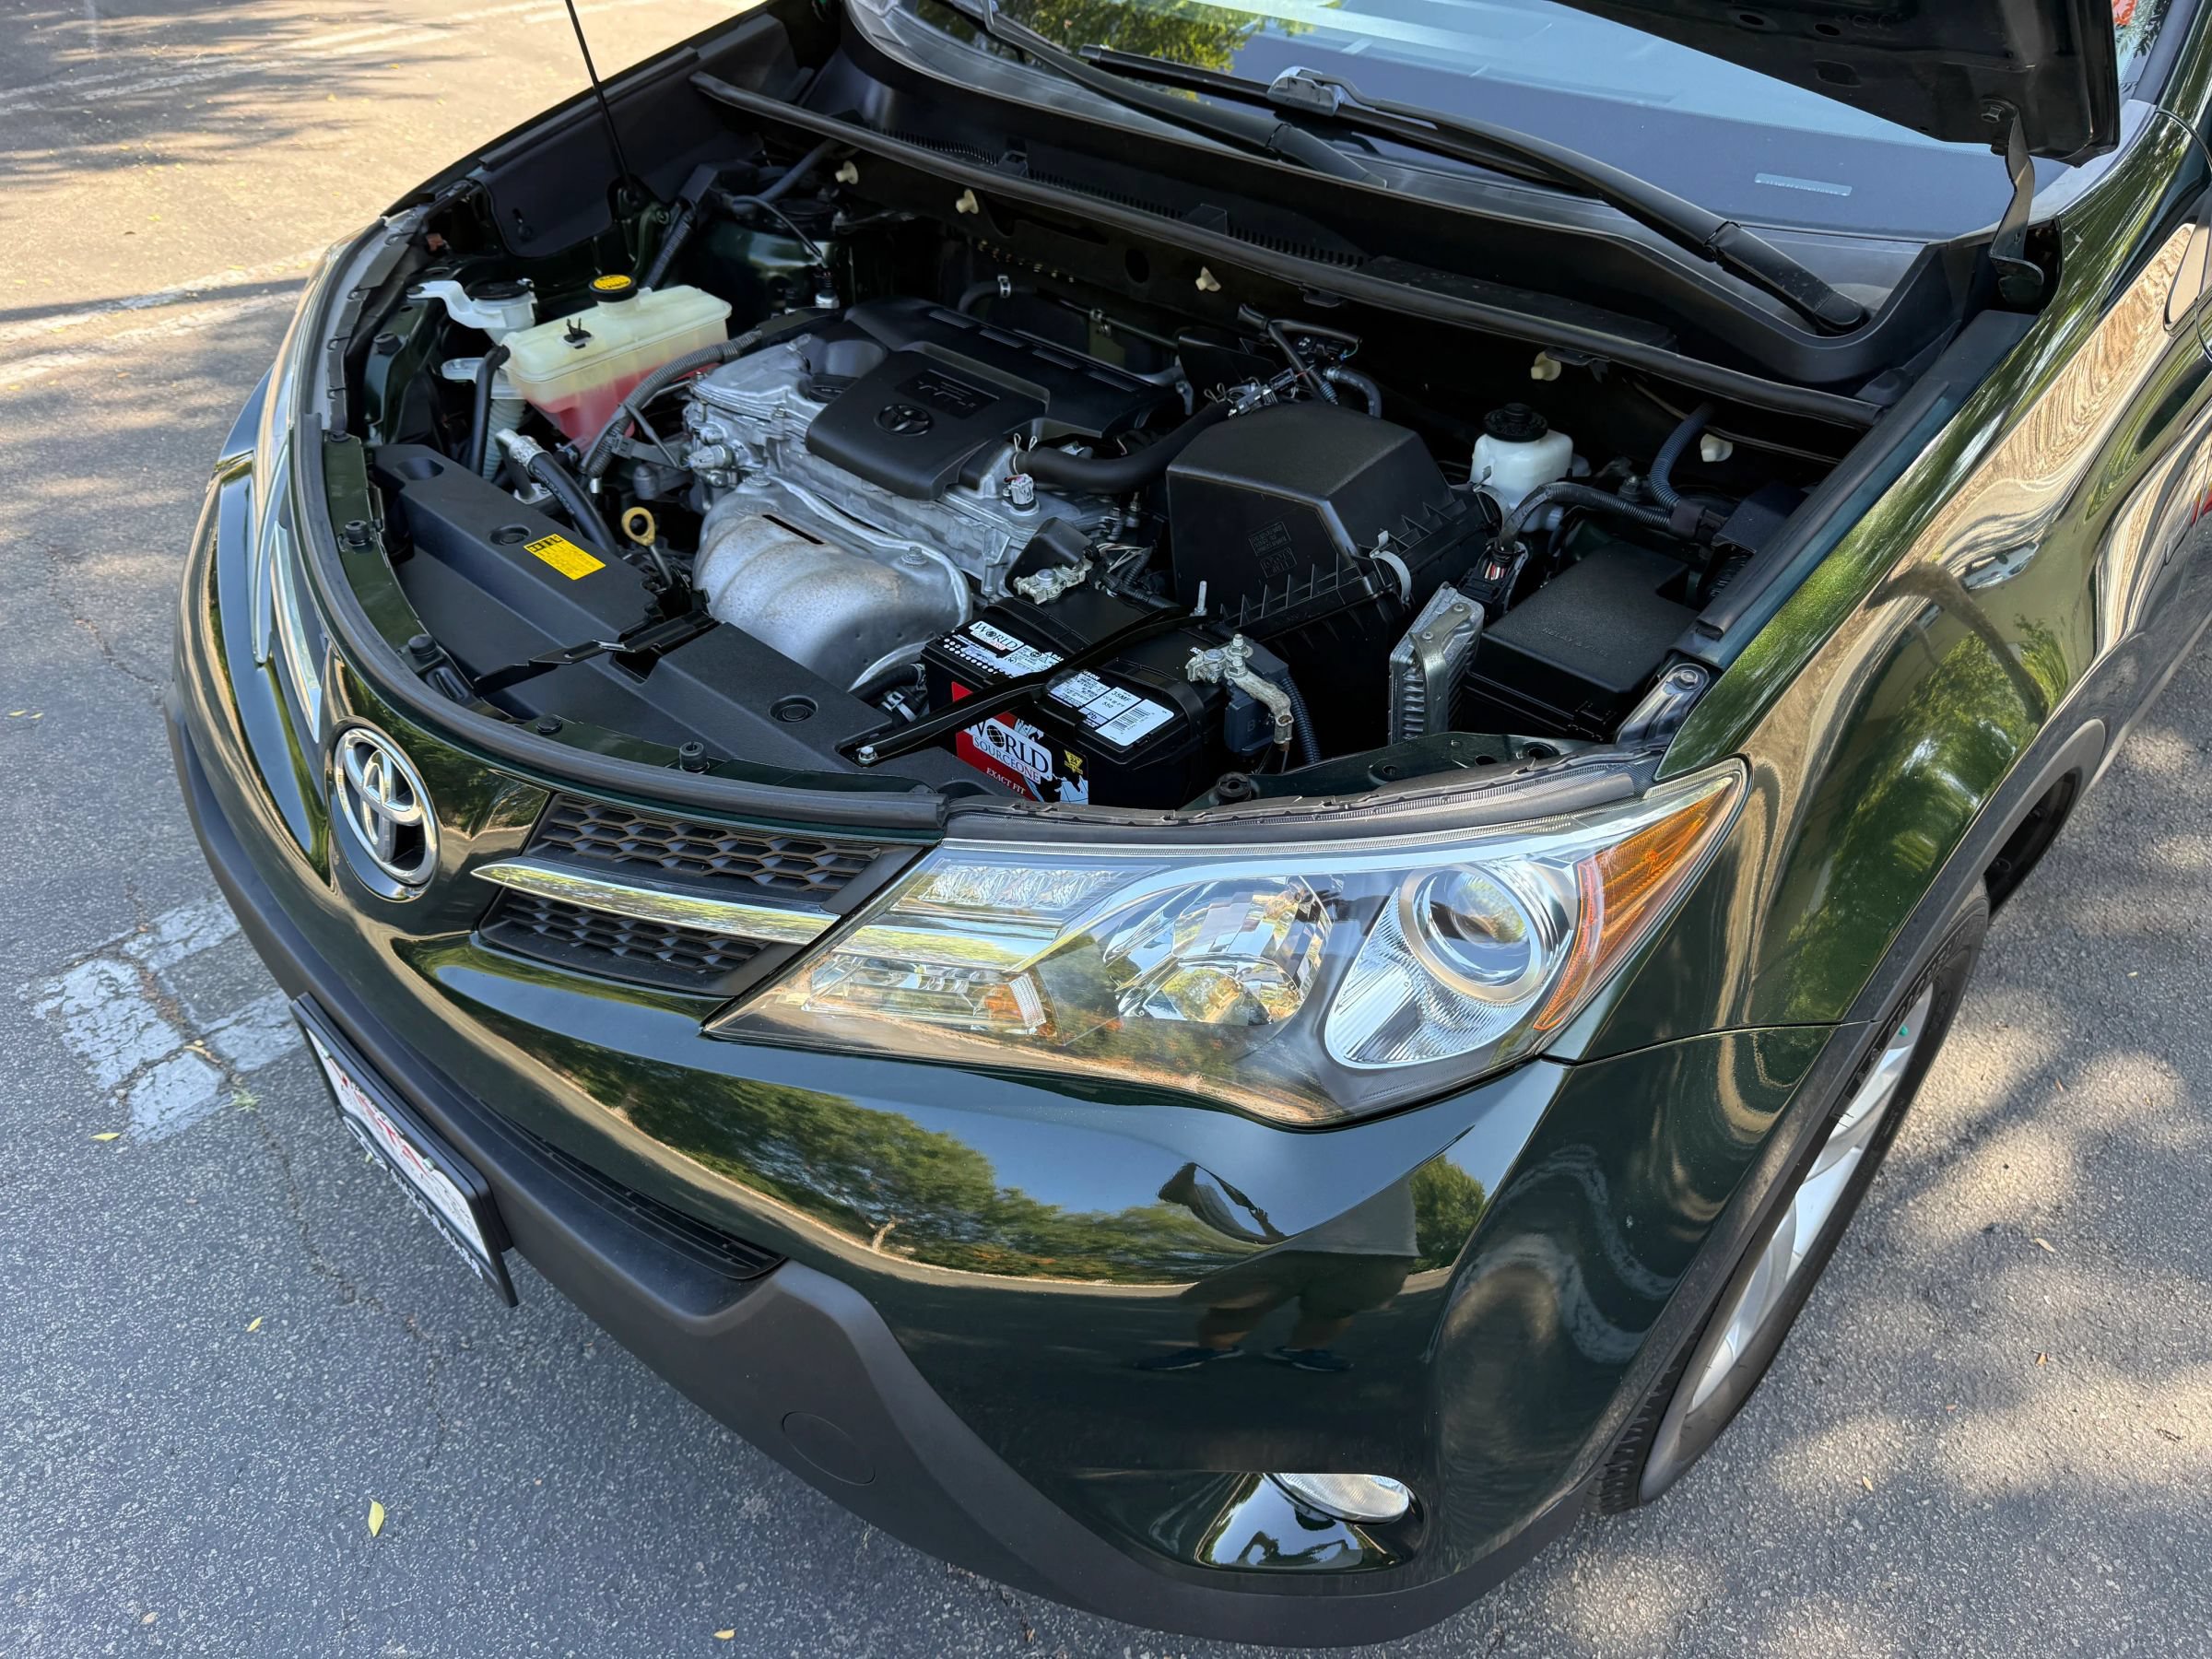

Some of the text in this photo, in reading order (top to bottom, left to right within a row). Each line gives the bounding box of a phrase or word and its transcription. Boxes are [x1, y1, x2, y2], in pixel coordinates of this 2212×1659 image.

[974, 736, 1041, 782] SOURCEONE
[986, 767, 1026, 794] EXACT FIT
